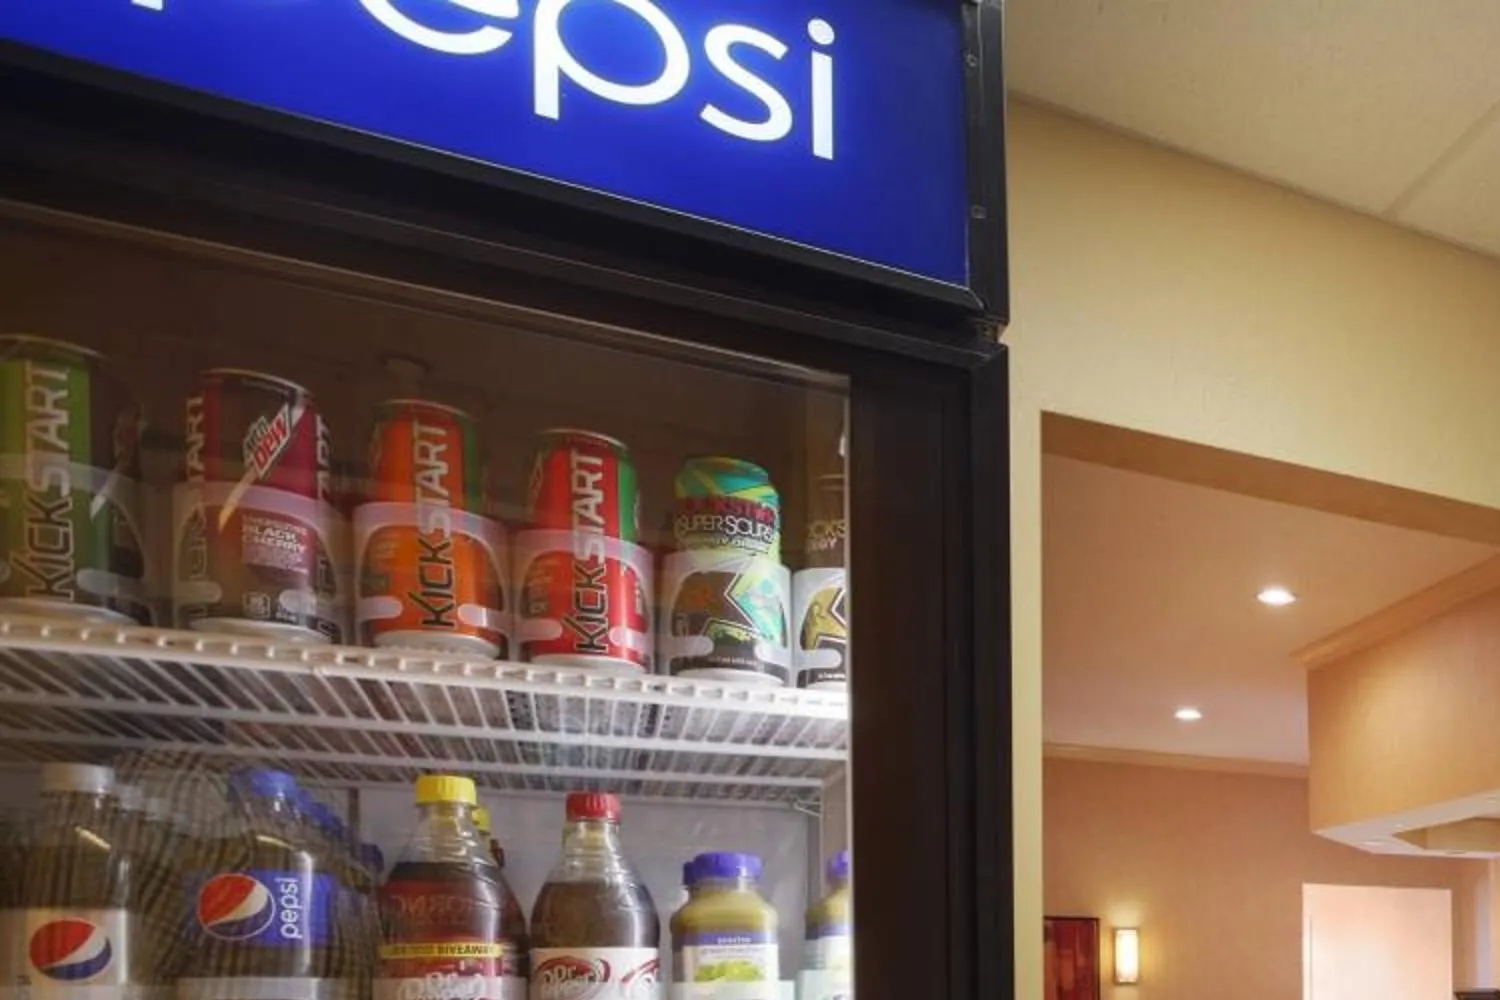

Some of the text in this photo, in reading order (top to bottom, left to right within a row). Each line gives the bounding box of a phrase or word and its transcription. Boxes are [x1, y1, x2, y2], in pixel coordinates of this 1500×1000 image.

[10, 360, 74, 601] KICKSTART
[407, 417, 456, 630] KICKSTART
[560, 449, 610, 653] KICKSTART
[275, 877, 303, 939] pepsi
